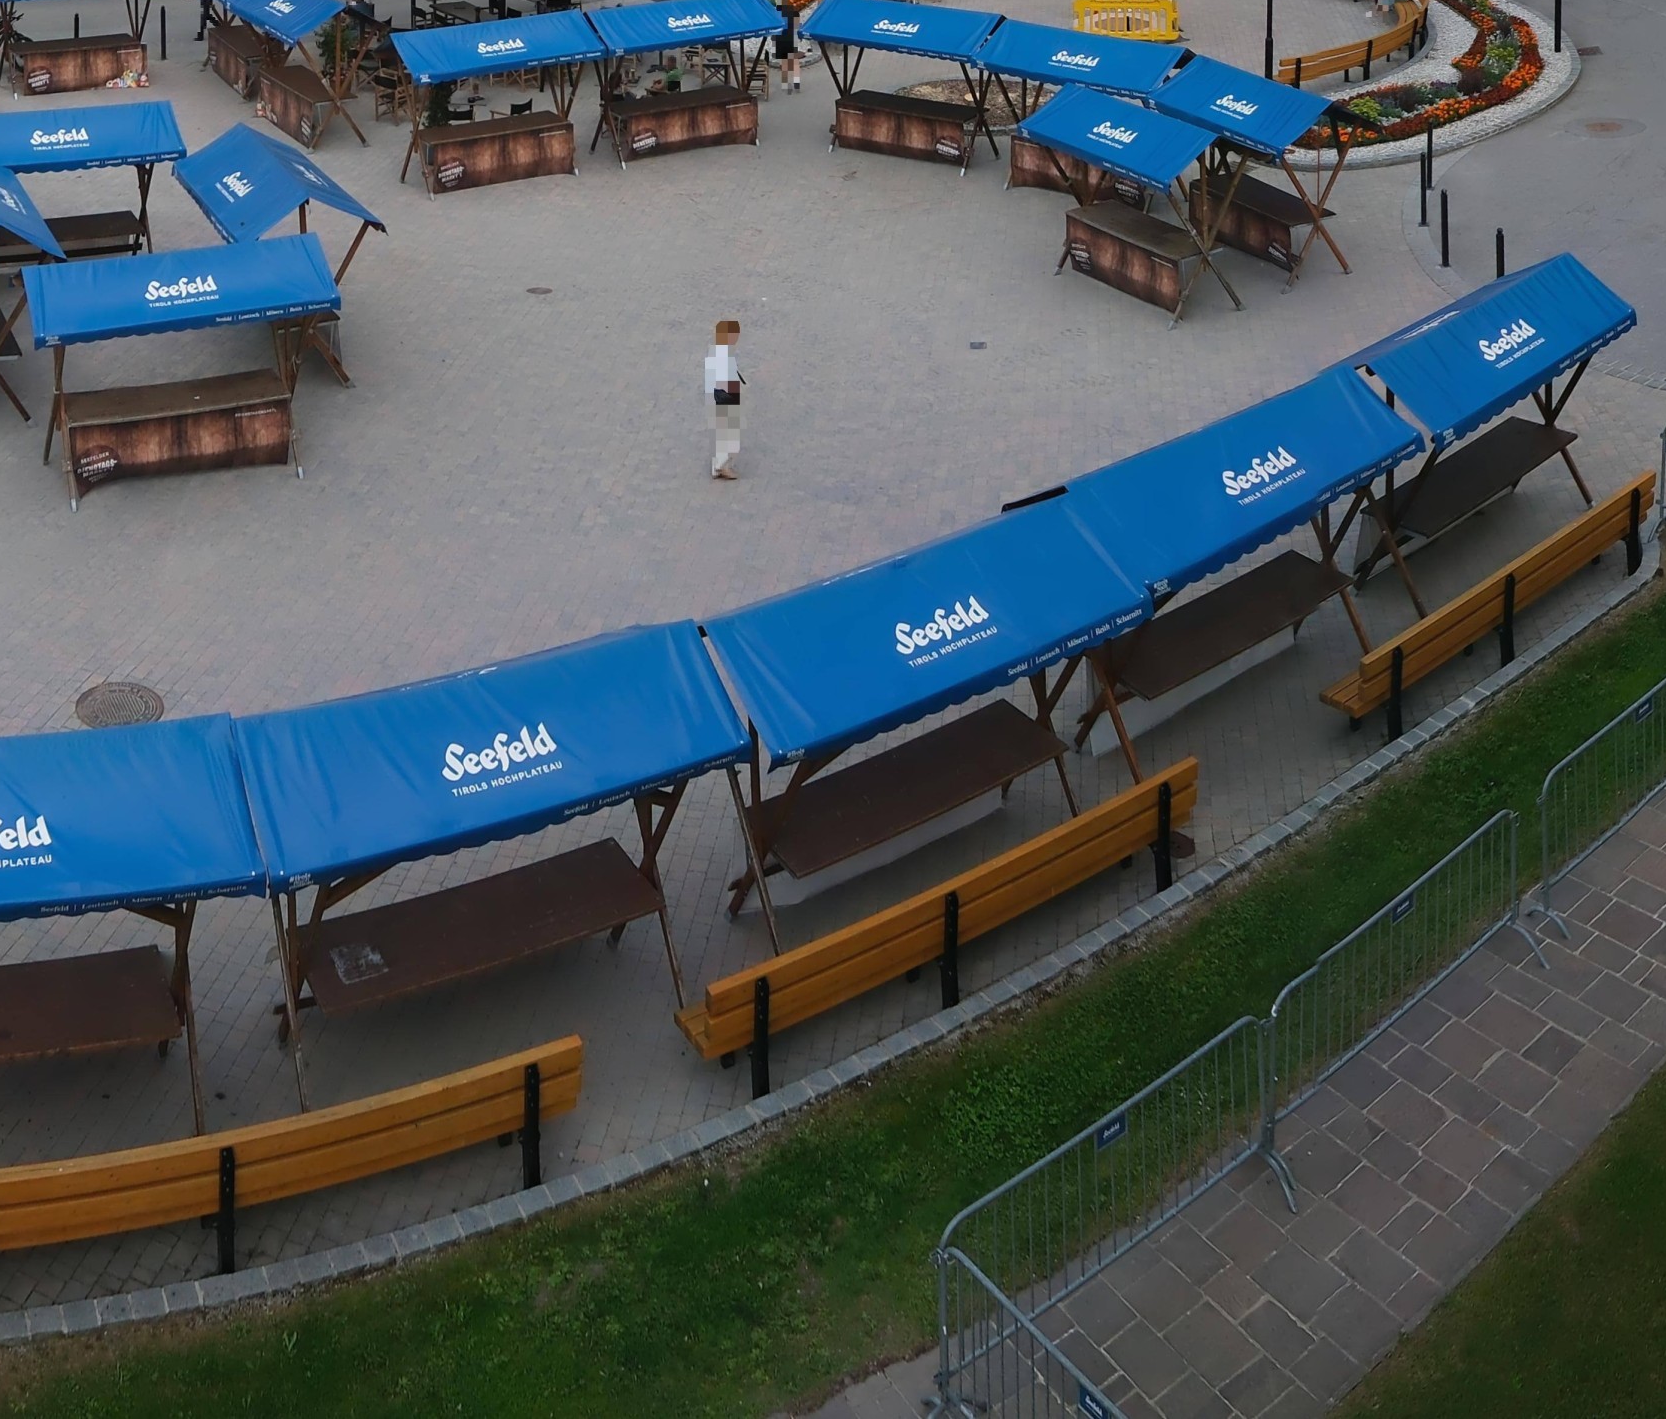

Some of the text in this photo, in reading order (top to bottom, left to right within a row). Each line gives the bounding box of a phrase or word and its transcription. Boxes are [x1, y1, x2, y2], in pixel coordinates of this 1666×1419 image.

[667, 13, 712, 30] Seefeld
[873, 19, 921, 35] Seefeld
[477, 37, 524, 54] Seefeld
[1051, 49, 1101, 69] Seefeld
[1216, 93, 1260, 117] Seefeld
[30, 127, 89, 145] Seefeld
[1092, 120, 1139, 146] Seefeld
[223, 171, 253, 198] Seefeld
[145, 275, 217, 301] Seefeld
[1477, 318, 1536, 362] Seefeld
[1222, 445, 1297, 496] Seefeld
[1237, 467, 1307, 507] TIROLS HOCHPLATEAU
[895, 595, 989, 656] Seefeld
[908, 625, 998, 668] TIROLS HOCHPLATEAU
[1007, 661, 1028, 677] Seefeld
[1035, 647, 1060, 664] Leutasch
[1066, 633, 1089, 650] Mösern
[1115, 607, 1143, 626] Scharnitz
[441, 722, 557, 782] Seefeld
[451, 760, 563, 798] TIROLS HOCHPLATEAU
